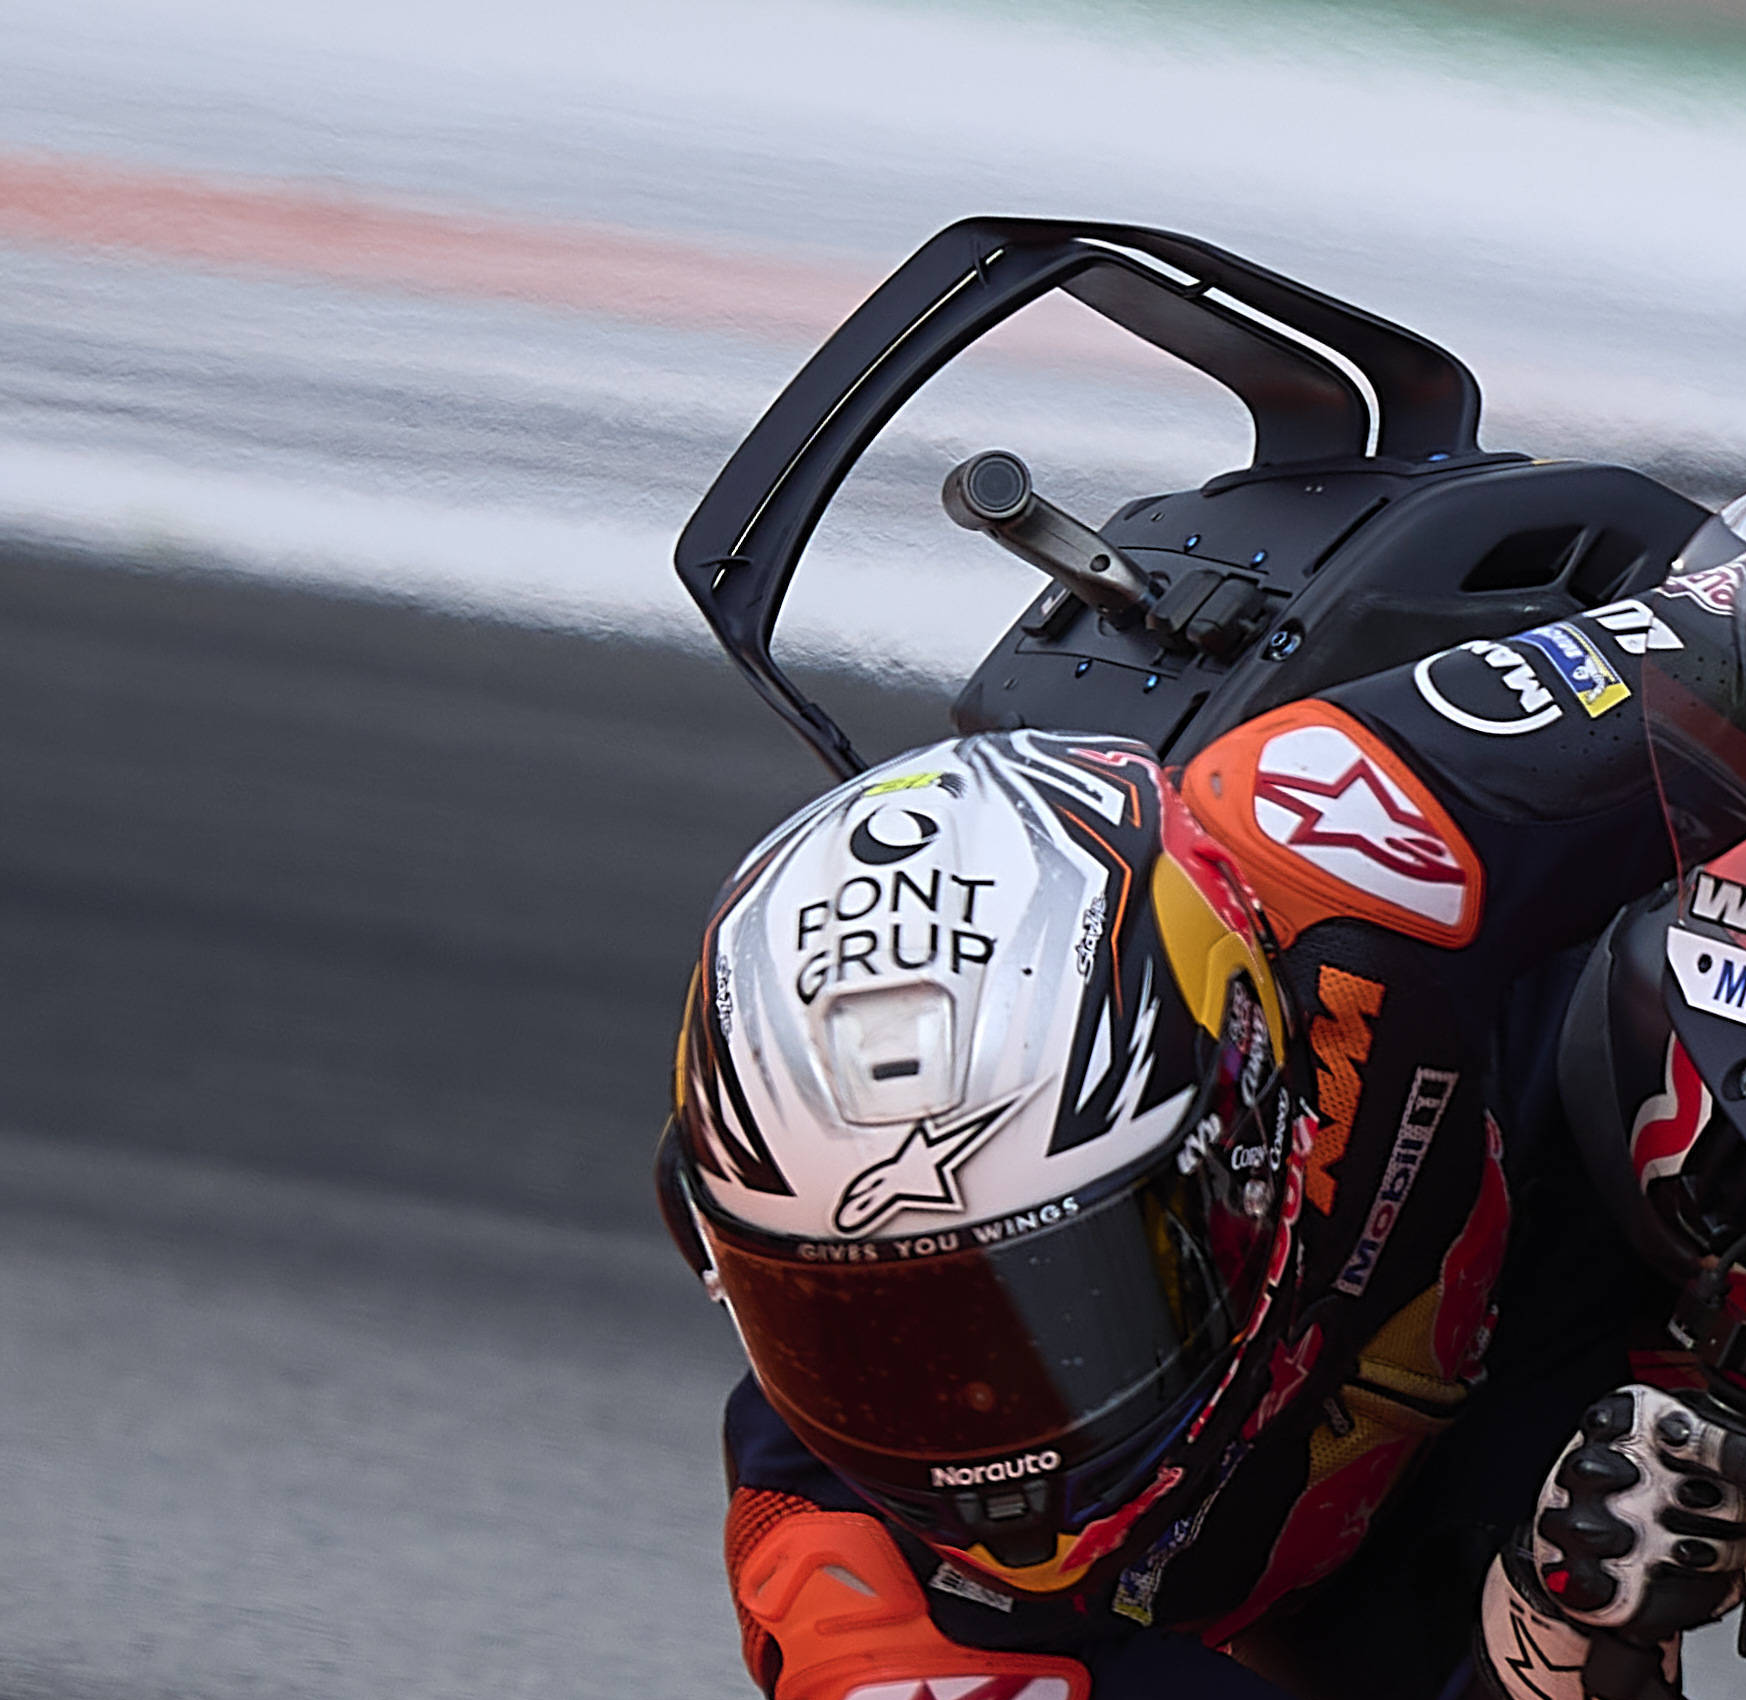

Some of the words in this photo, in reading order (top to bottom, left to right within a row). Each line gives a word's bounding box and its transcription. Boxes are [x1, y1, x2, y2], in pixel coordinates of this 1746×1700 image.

[797, 868, 996, 952] FONT
[797, 921, 996, 1004] GRUP
[1304, 966, 1386, 1217] KTM
[799, 1243, 878, 1263] GIVES
[893, 1232, 958, 1258] YOU
[971, 1196, 1080, 1243] WINGS
[1342, 1138, 1424, 1286] Mobil
[930, 1450, 1061, 1487] Norauto
